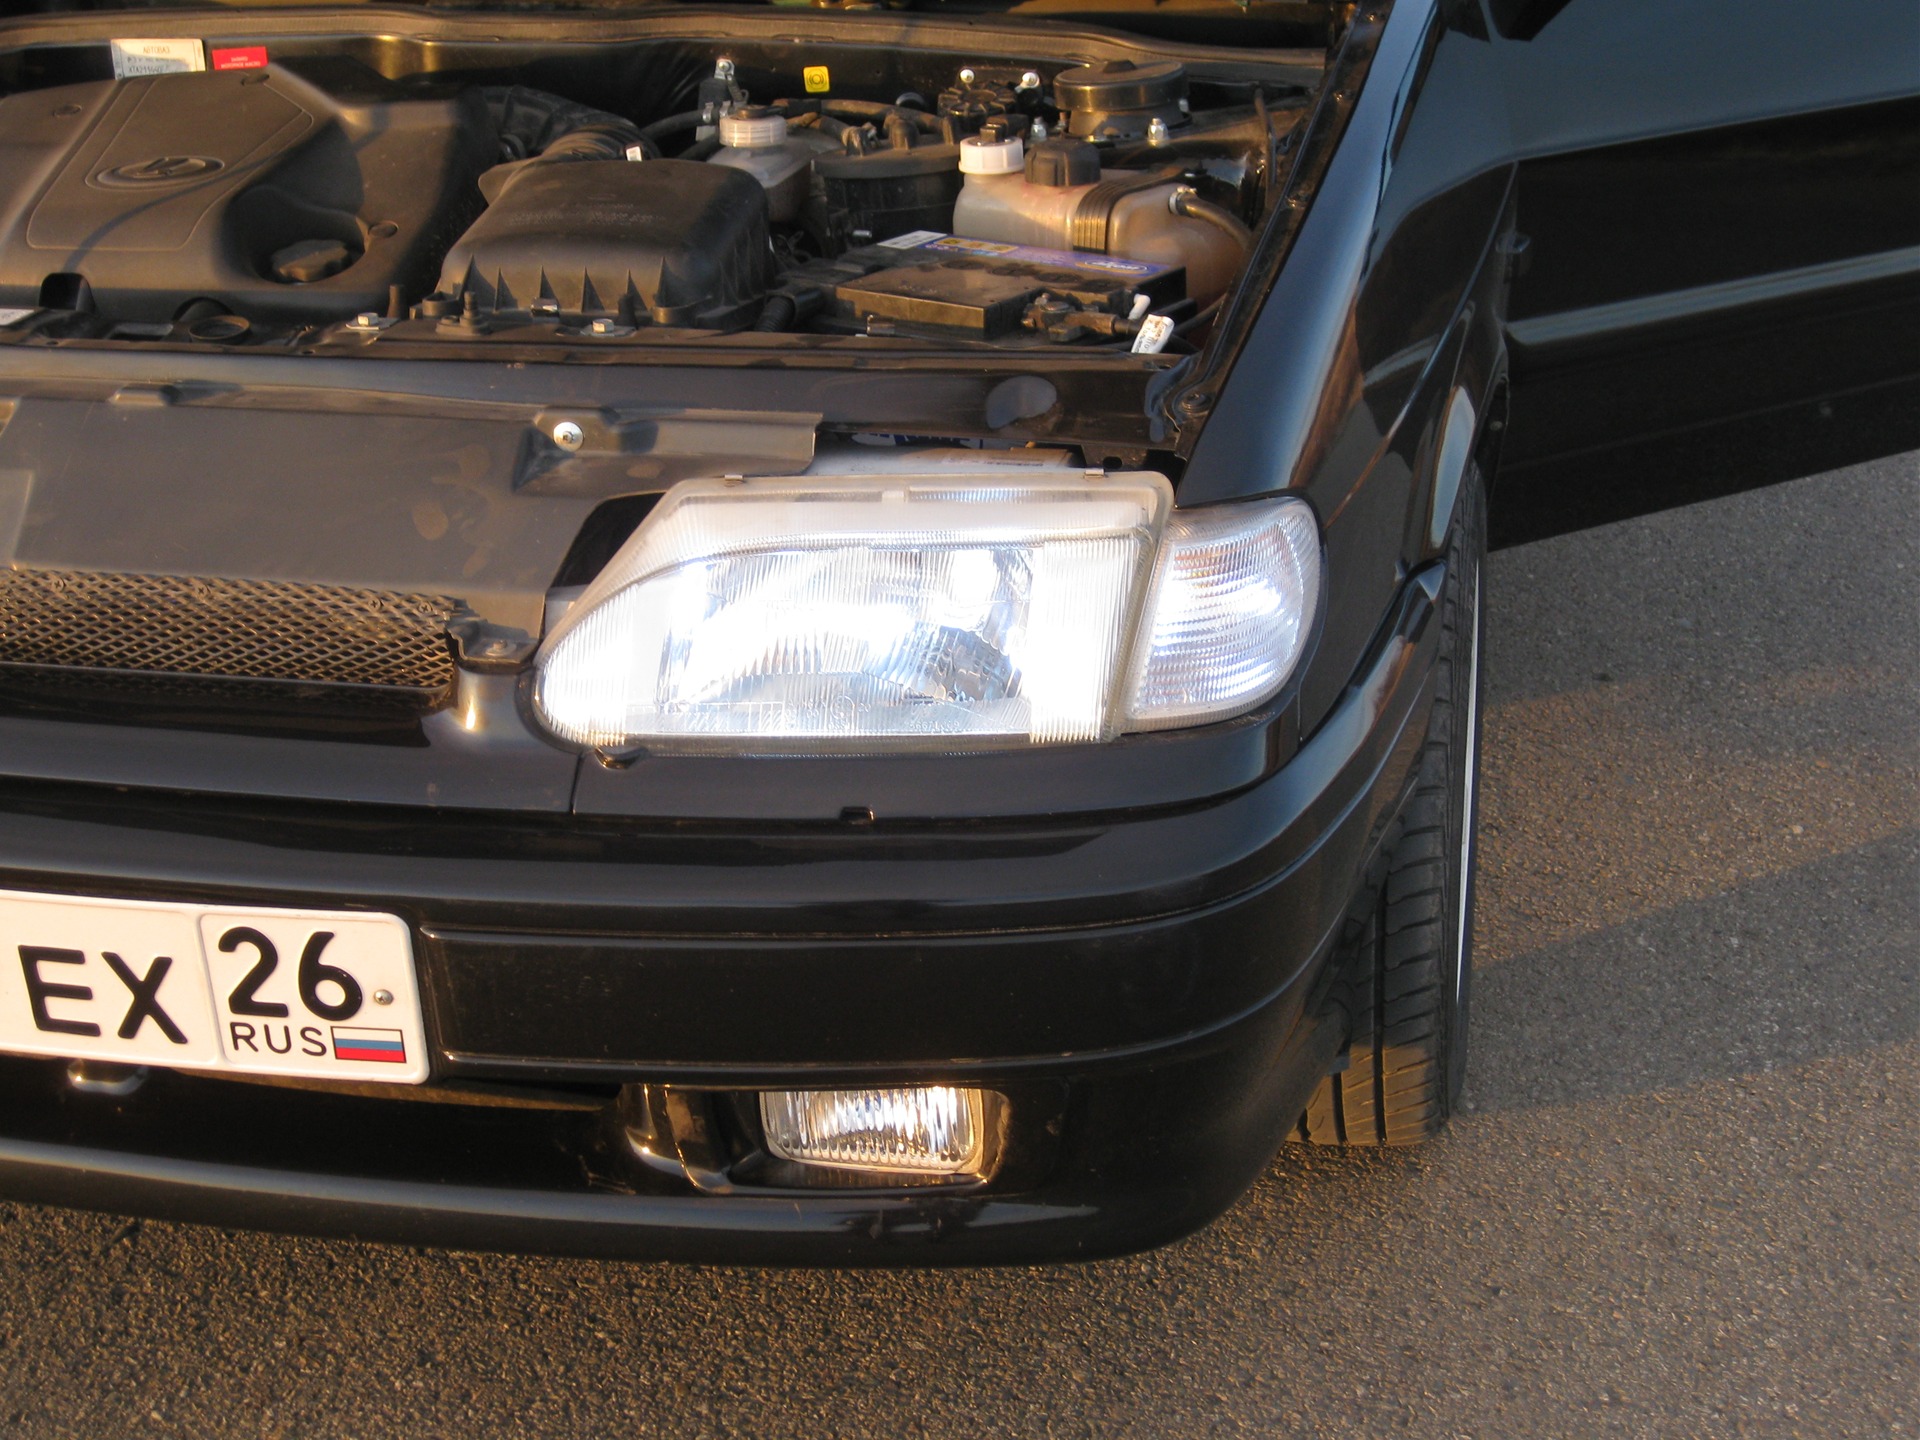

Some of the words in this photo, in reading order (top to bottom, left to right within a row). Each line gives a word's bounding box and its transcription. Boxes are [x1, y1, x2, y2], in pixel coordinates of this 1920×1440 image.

[18, 944, 188, 1044] EX
[217, 926, 363, 1021] 26
[229, 1022, 327, 1056] RUS
